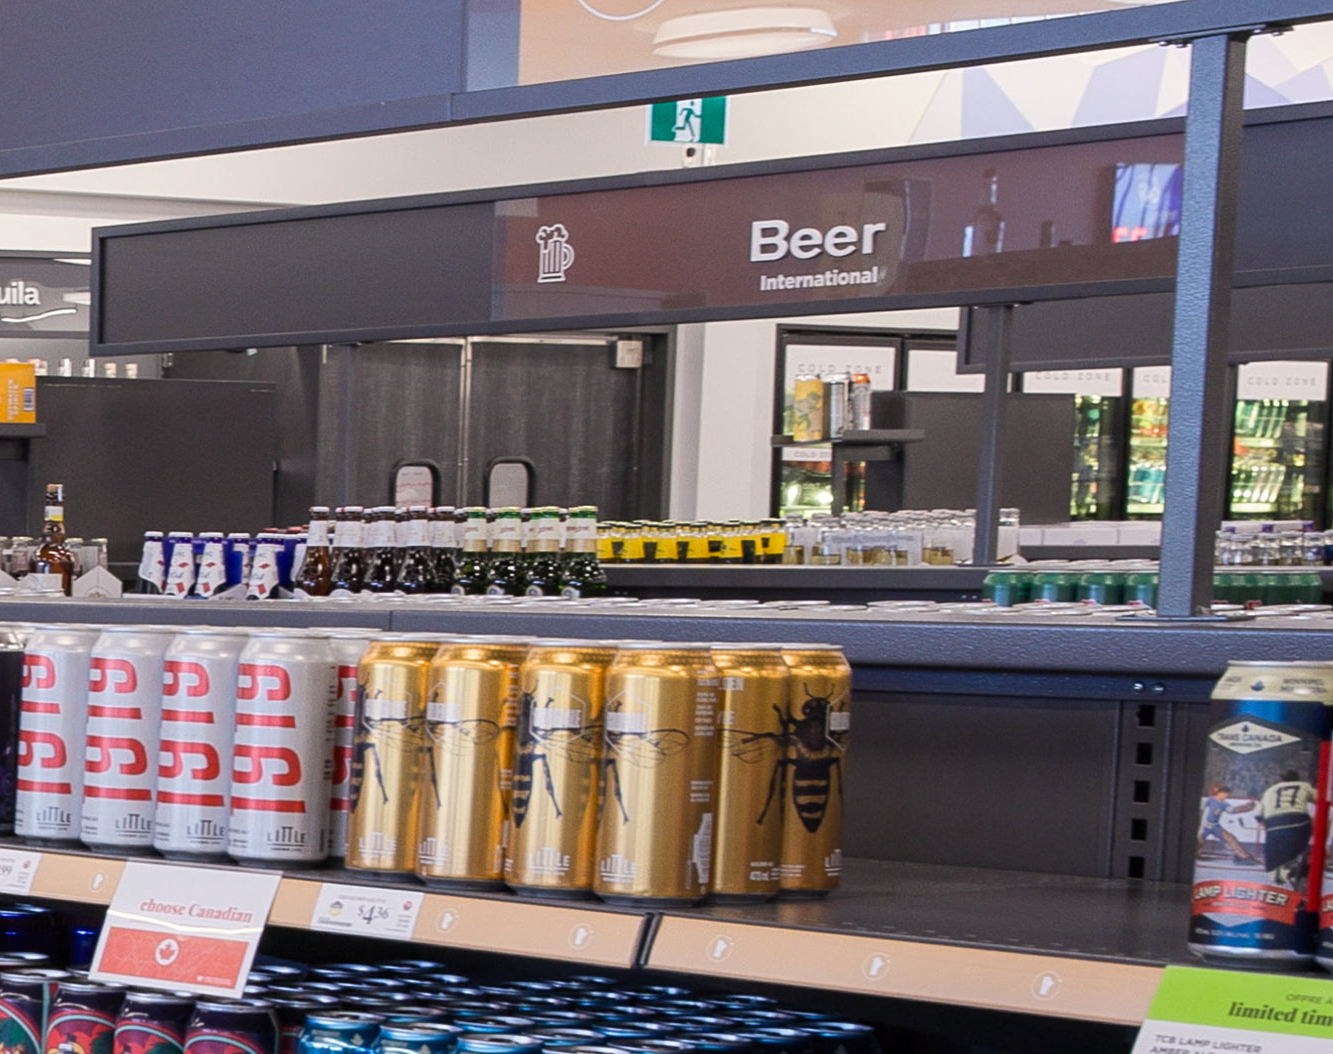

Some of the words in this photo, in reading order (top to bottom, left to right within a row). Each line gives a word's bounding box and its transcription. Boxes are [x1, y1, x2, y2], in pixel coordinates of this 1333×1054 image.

[750, 220, 886, 263] Beer
[760, 266, 878, 291] International
[83, 656, 152, 803] 1919
[156, 659, 224, 807] 1919
[230, 663, 306, 816] 1919
[1276, 786, 1301, 808] 17
[1224, 886, 1289, 906] LIGHTER
[140, 898, 185, 917] choose
[188, 903, 252, 923] Canadian
[1228, 1002, 1297, 1023] limited
[1300, 1012, 1333, 1027] tim
[1179, 1037, 1210, 1047] LAMP
[1213, 1041, 1262, 1054] LIGHTER
